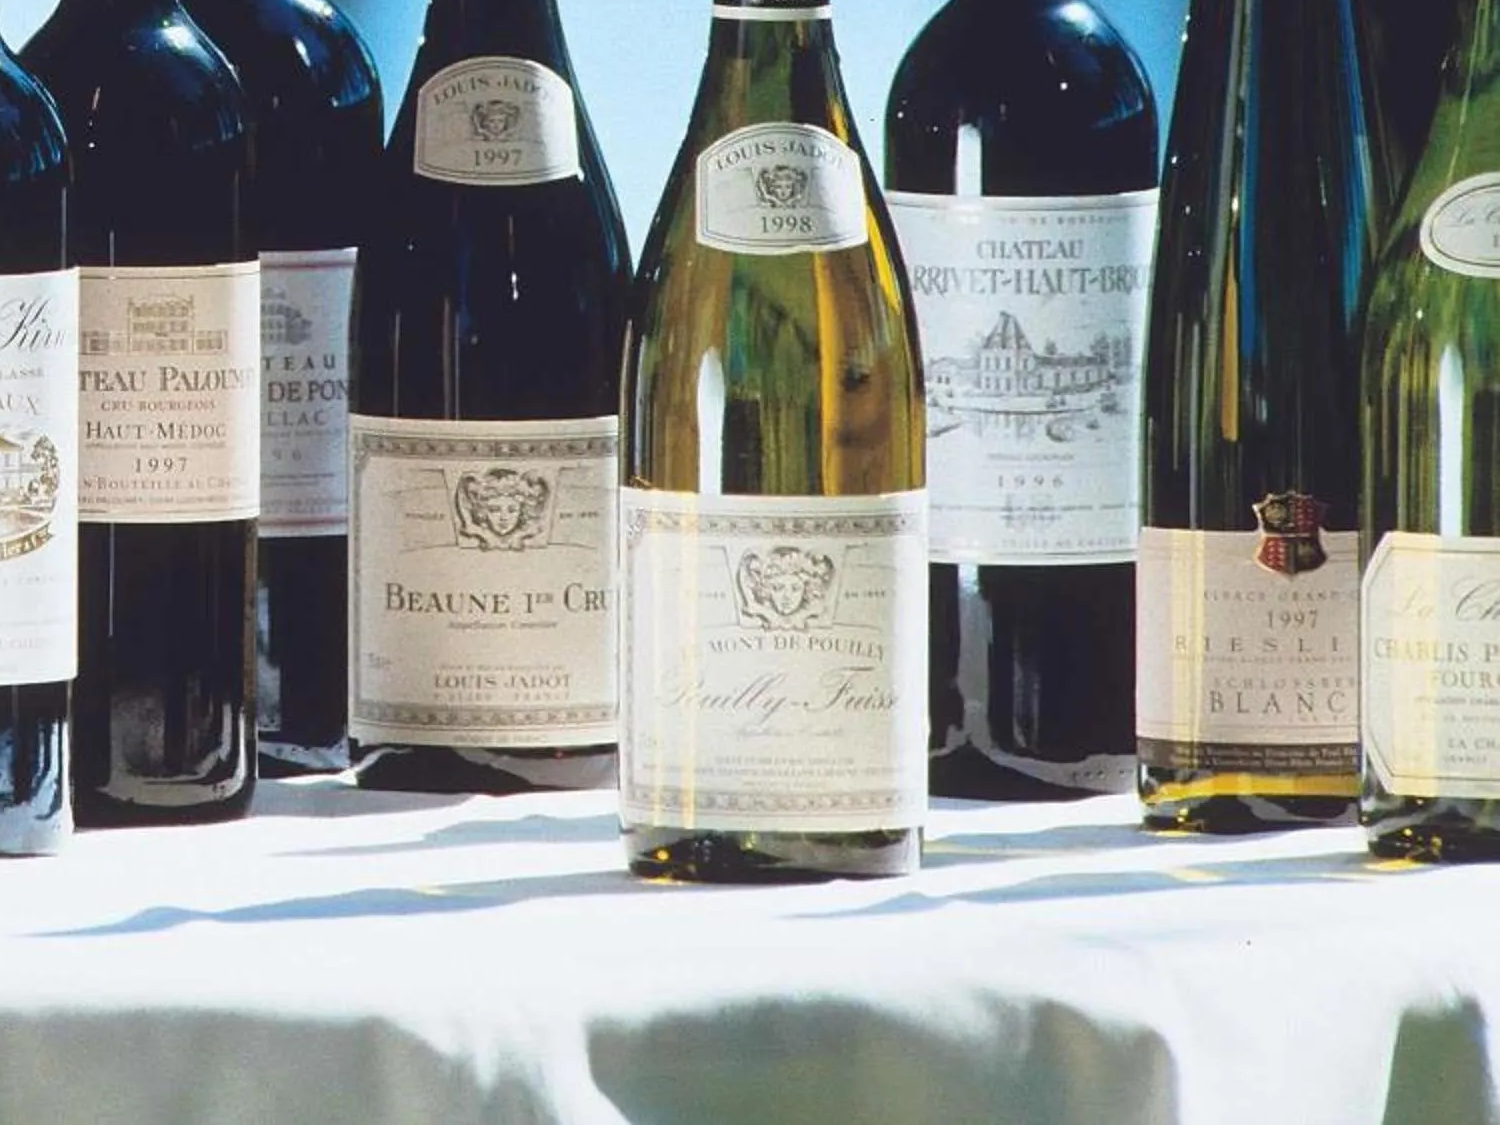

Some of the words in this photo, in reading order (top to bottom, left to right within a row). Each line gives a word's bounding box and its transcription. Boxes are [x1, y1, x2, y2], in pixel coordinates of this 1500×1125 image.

[433, 77, 491, 106] LOUIS
[472, 150, 523, 167] 1997
[715, 140, 776, 172] LOUIS
[759, 216, 813, 234] 1998
[268, 381, 302, 403] DE
[133, 456, 189, 474] 1997
[386, 582, 511, 614] BEAUNE
[709, 633, 767, 654] MONT
[772, 632, 801, 652] DE
[807, 635, 885, 662] POUILLY
[1373, 636, 1469, 663] CHABLIS
[434, 674, 497, 689] LOUIS
[503, 673, 570, 689] JADOT
